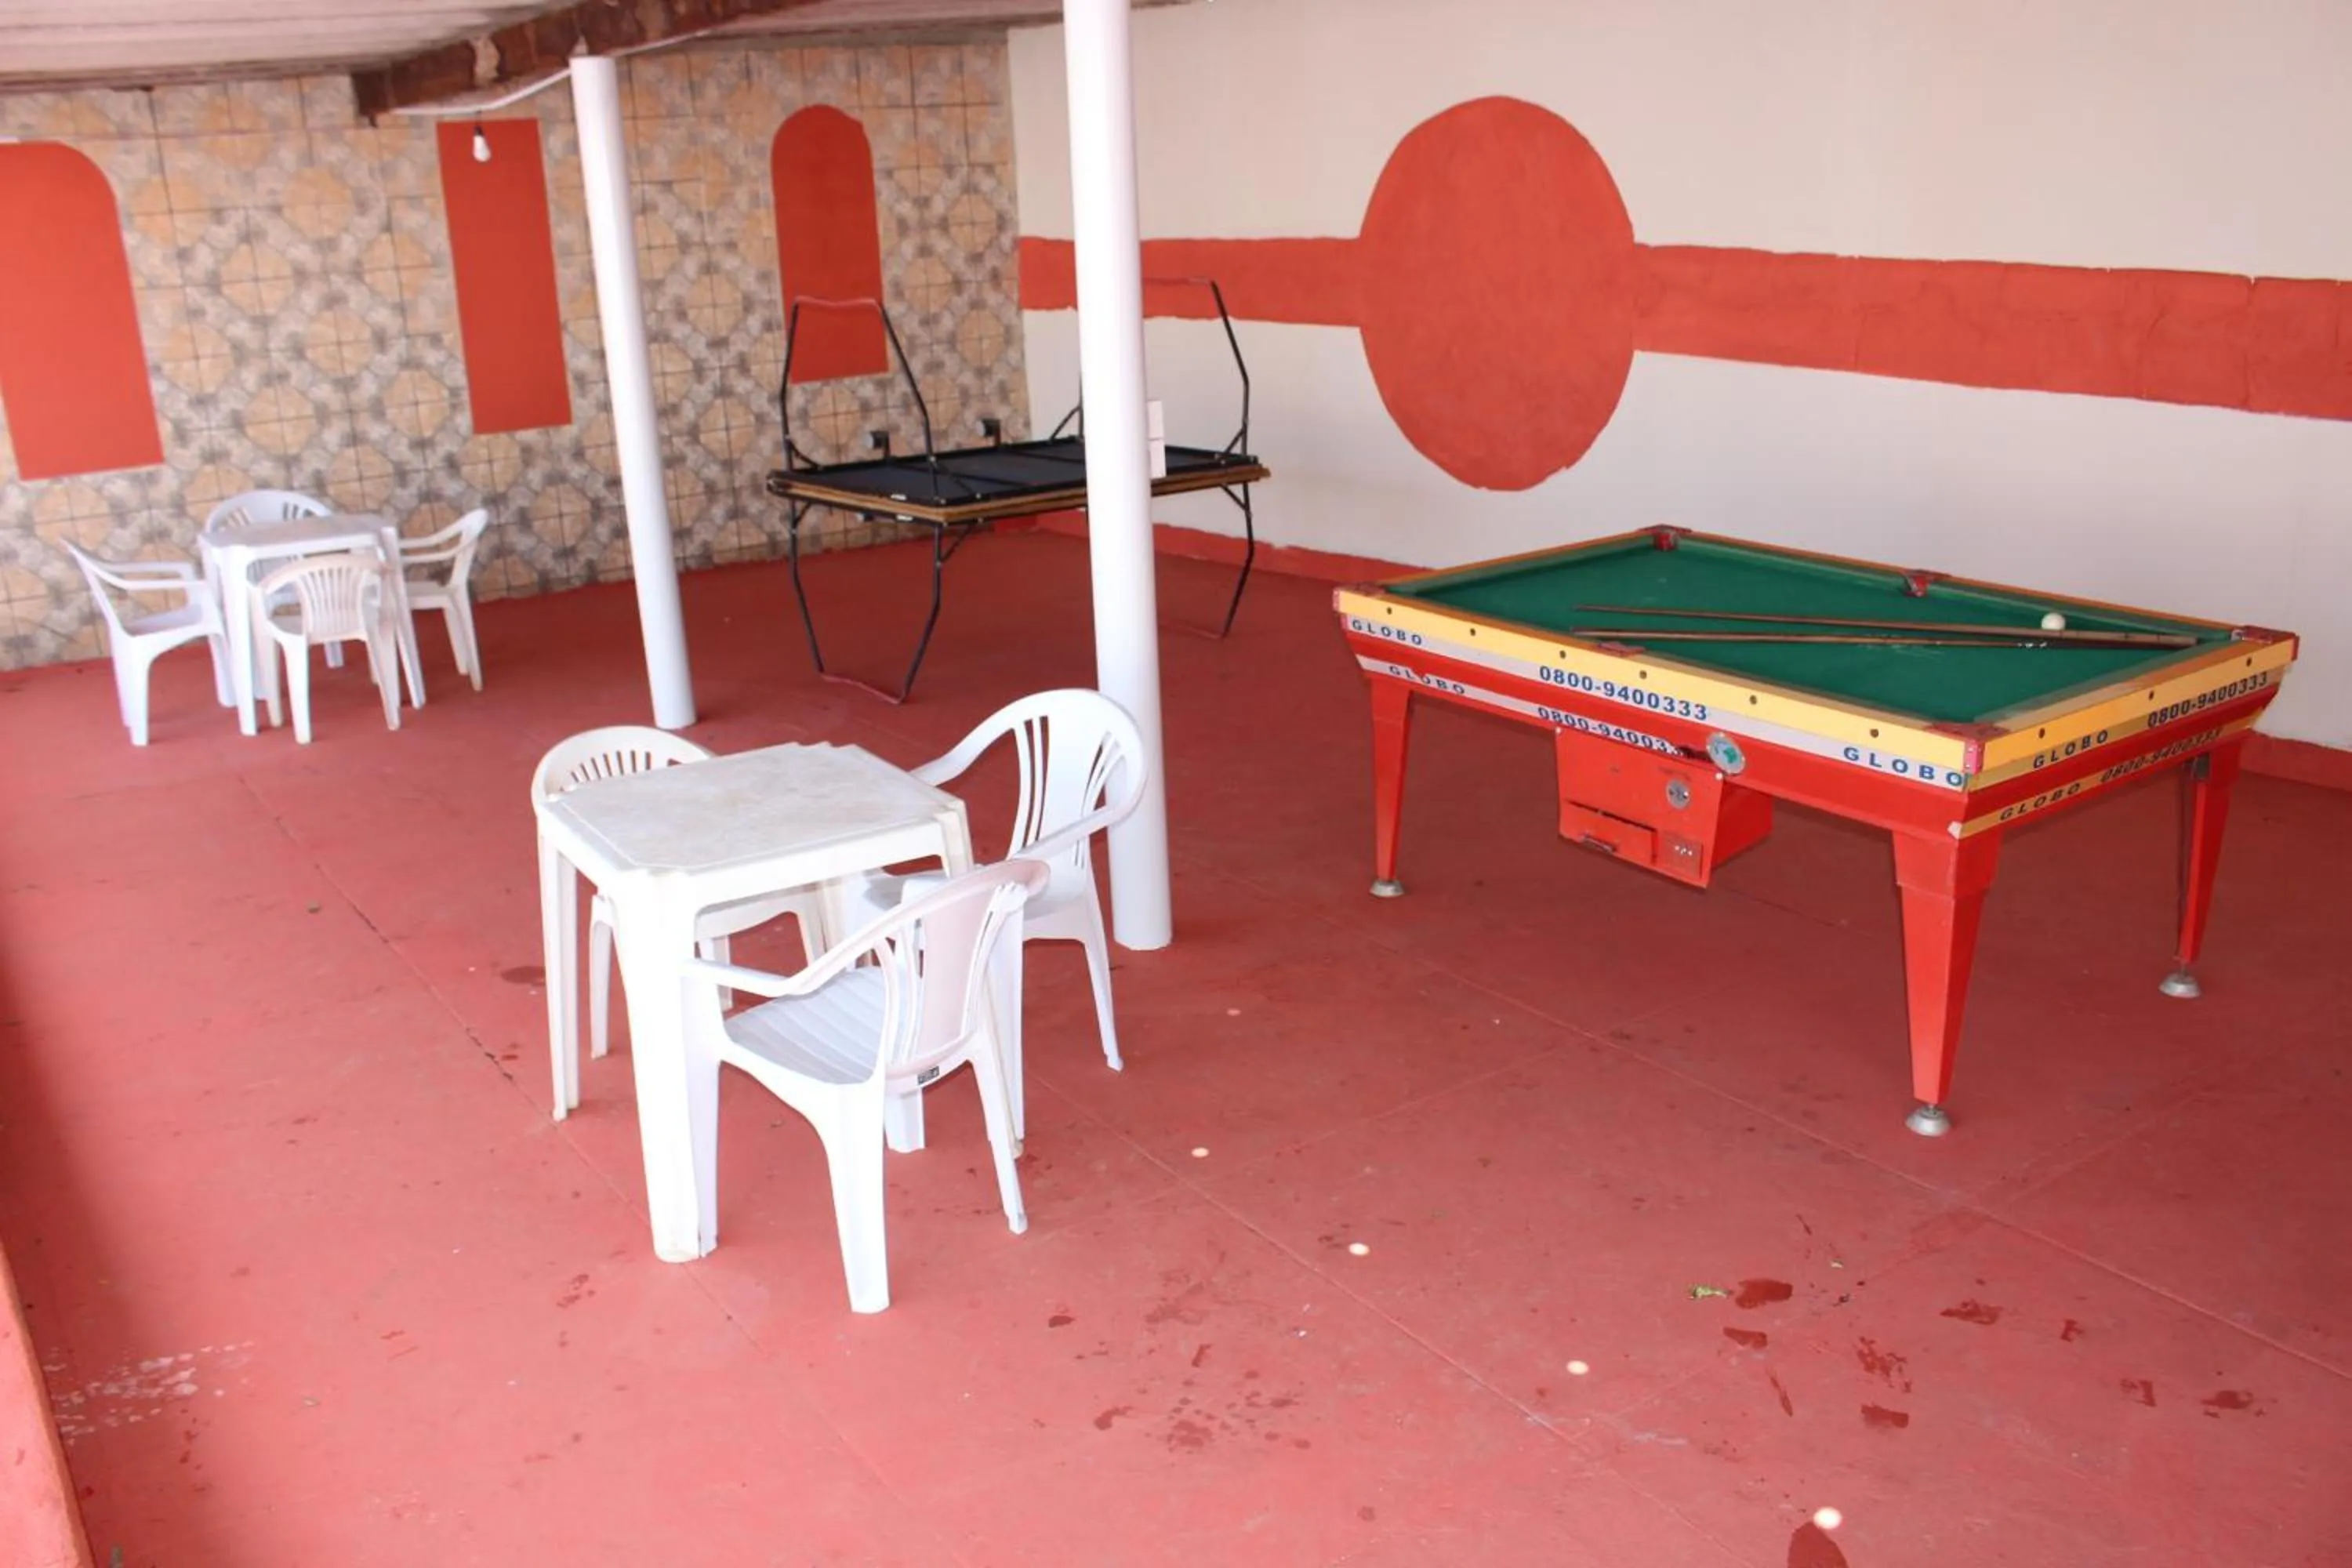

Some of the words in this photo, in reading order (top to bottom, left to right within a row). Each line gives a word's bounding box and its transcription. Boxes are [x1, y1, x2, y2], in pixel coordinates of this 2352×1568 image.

[1352, 619, 1422, 645] GLOBO
[1539, 665, 1708, 721] 0800-9400333
[1843, 746, 1963, 787] GLOBO
[2033, 729, 2108, 769] GLOBO
[2147, 671, 2268, 728] 0800-9400333
[2000, 782, 2081, 821] GLOBO
